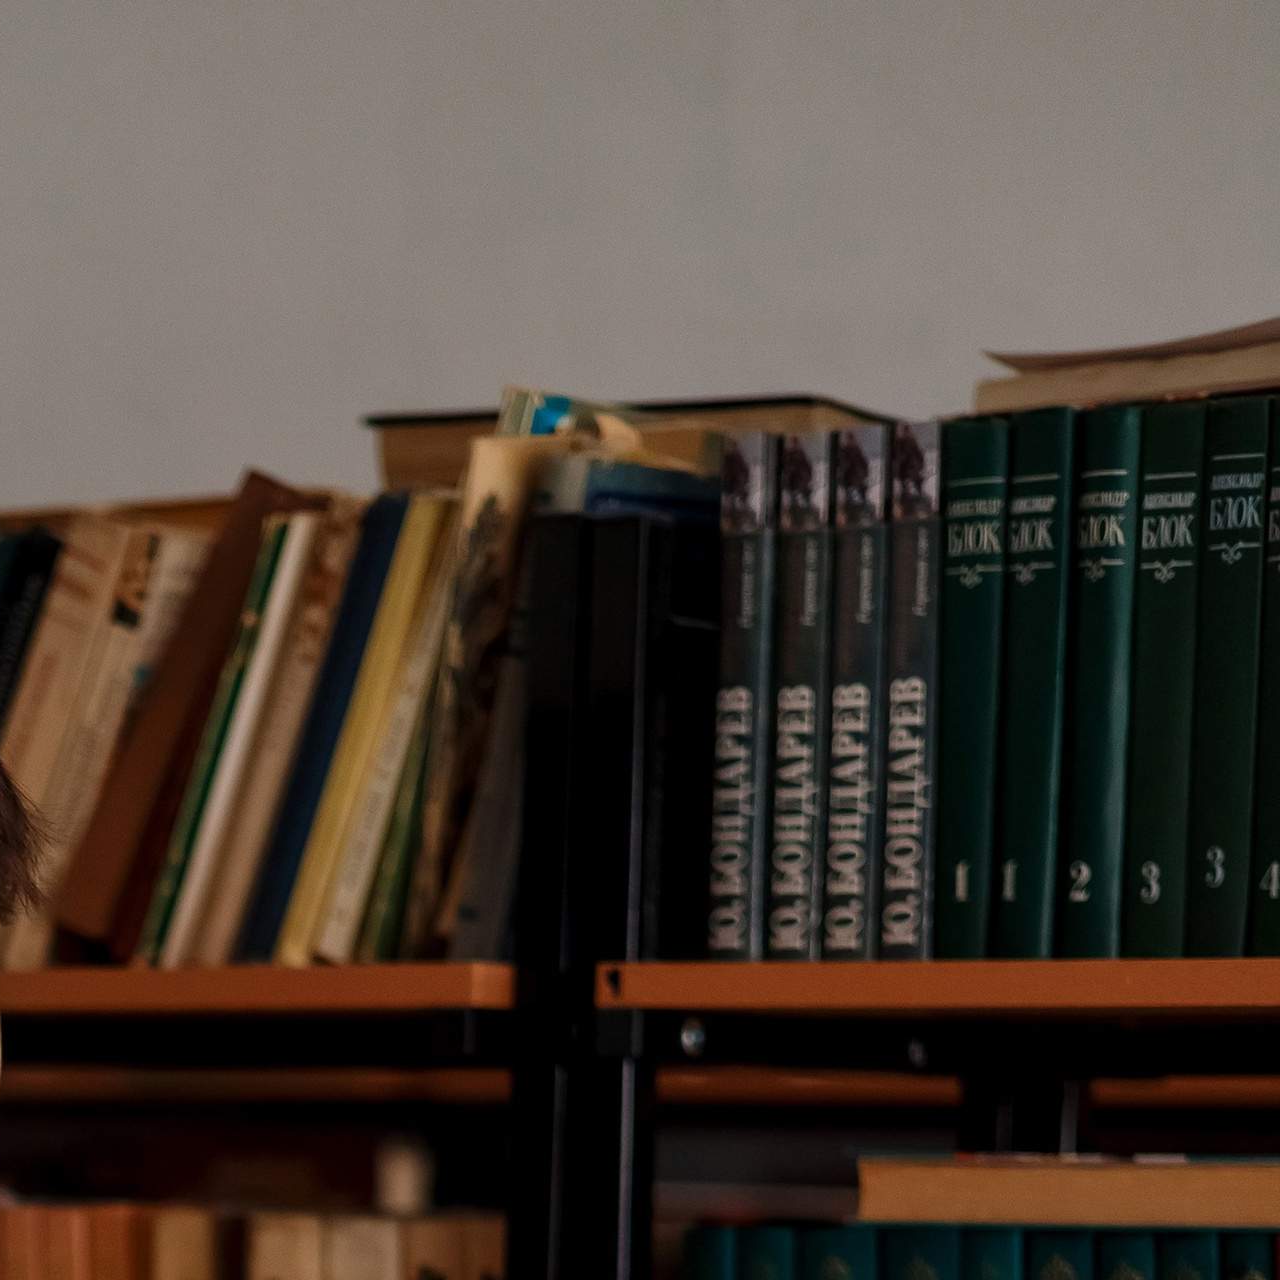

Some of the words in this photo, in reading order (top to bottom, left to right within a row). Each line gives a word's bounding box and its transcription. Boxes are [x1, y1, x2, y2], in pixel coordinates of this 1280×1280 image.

[1078, 514, 1125, 548] БЛОК
[1210, 496, 1263, 531] БЛОК
[947, 521, 1002, 557] БЛОК
[1009, 518, 1054, 553] БЛОК
[1142, 515, 1194, 550] БЛОК
[955, 860, 969, 902] 1
[1069, 860, 1092, 902] 2
[1140, 860, 1161, 904] 3
[1205, 845, 1225, 888] 3
